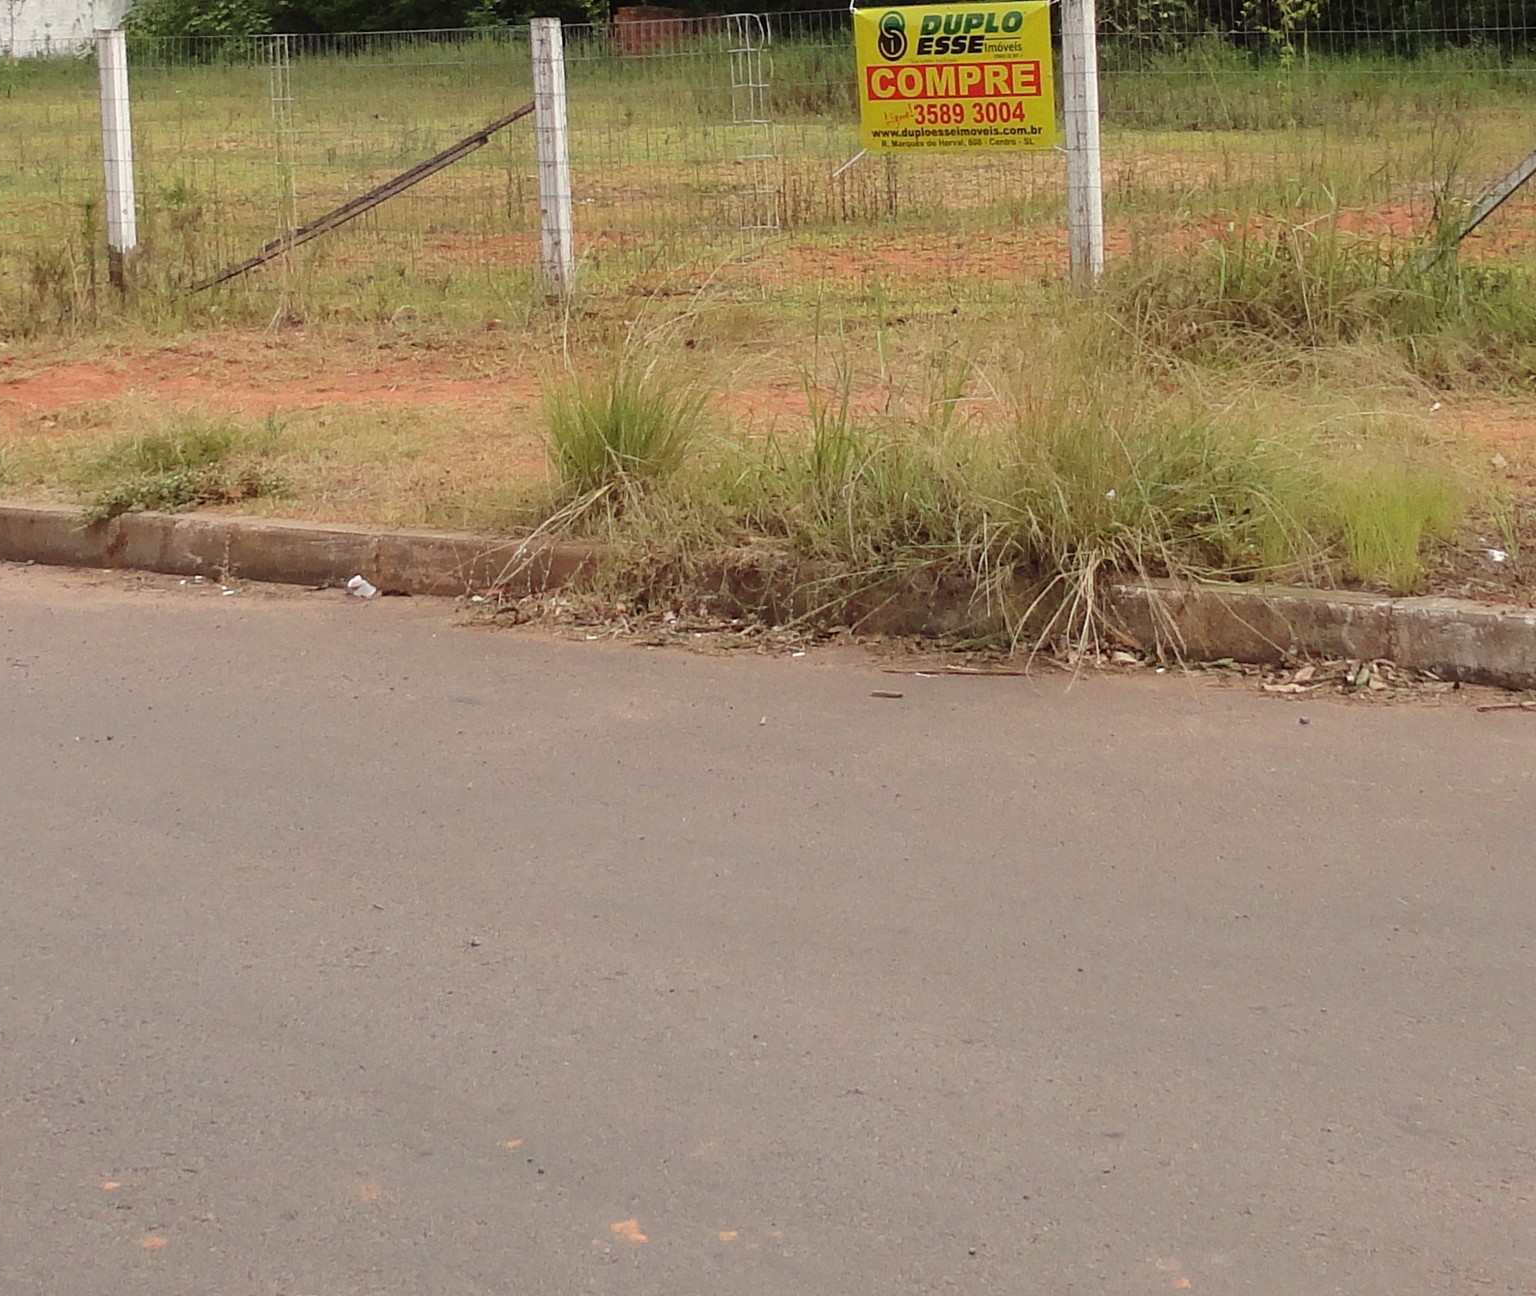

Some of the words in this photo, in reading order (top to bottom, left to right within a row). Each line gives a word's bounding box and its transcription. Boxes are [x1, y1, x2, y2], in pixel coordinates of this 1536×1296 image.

[920, 11, 1024, 36] DUPLO
[917, 35, 985, 56] ESSE
[985, 41, 1023, 53] Imóveis
[871, 64, 1037, 98] COMPRE
[914, 103, 965, 125] 3589
[972, 101, 1026, 124] 3004
[871, 125, 1043, 142] www.duploesseimoveis.com.br
[989, 137, 1016, 146] Centro
